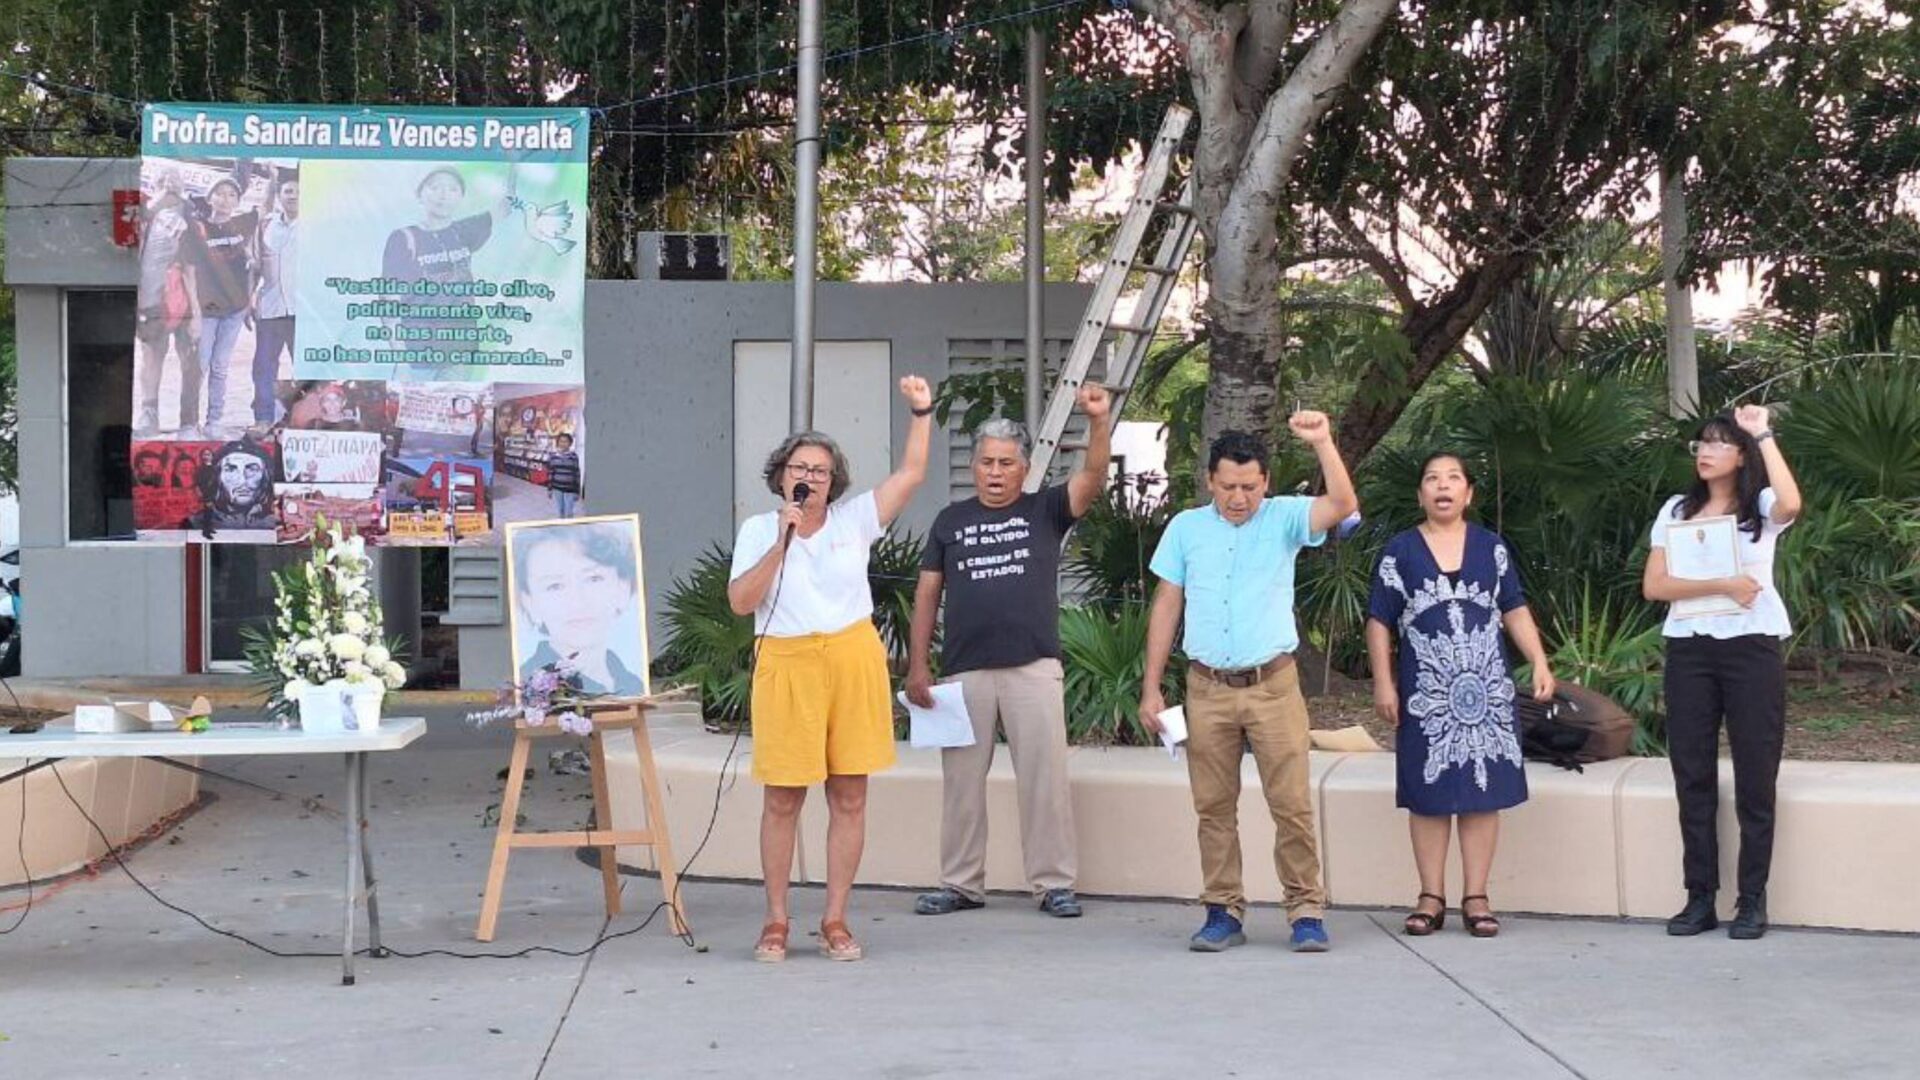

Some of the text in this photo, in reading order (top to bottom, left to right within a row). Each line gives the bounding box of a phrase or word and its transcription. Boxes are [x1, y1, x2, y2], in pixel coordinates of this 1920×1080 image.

[152, 113, 573, 150] Profra. Sandra Luz Vences Peralta
[412, 279, 439, 296] de
[442, 279, 498, 297] verde
[501, 280, 555, 299] olivo,
[485, 303, 532, 323] viva,
[365, 323, 513, 345] no has muerto,
[304, 346, 331, 362] no
[334, 345, 371, 363] has
[374, 347, 446, 364] muerto
[1014, 548, 1030, 559] DE
